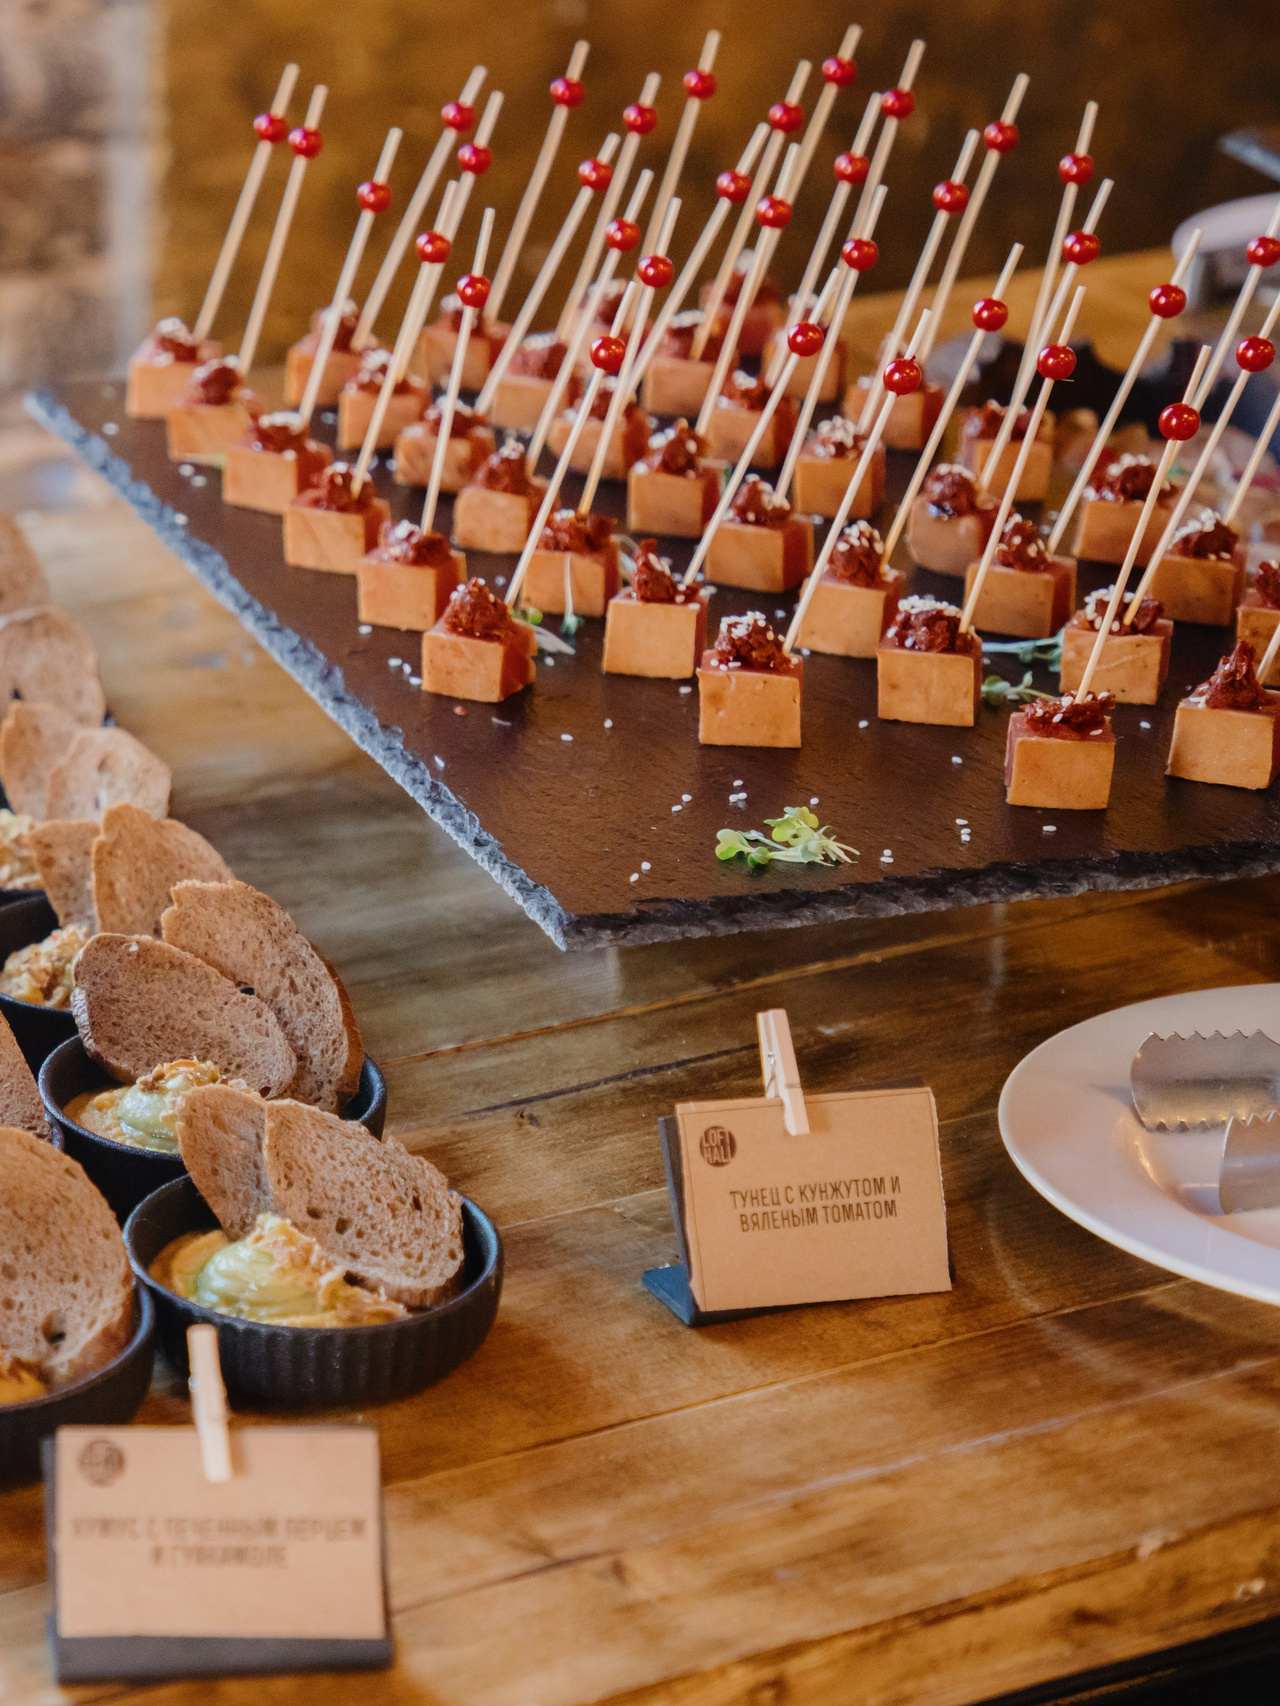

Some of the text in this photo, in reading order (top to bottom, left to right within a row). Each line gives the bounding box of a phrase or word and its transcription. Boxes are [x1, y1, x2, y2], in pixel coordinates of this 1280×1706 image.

[702, 1129, 731, 1147] LOFT
[703, 1146, 732, 1163] HALL
[730, 1176, 901, 1210] ТУНЕЦ С КУНЖУТОМ И
[740, 1199, 897, 1232] ВЯЛЕНЫМ ТОМАТОМ
